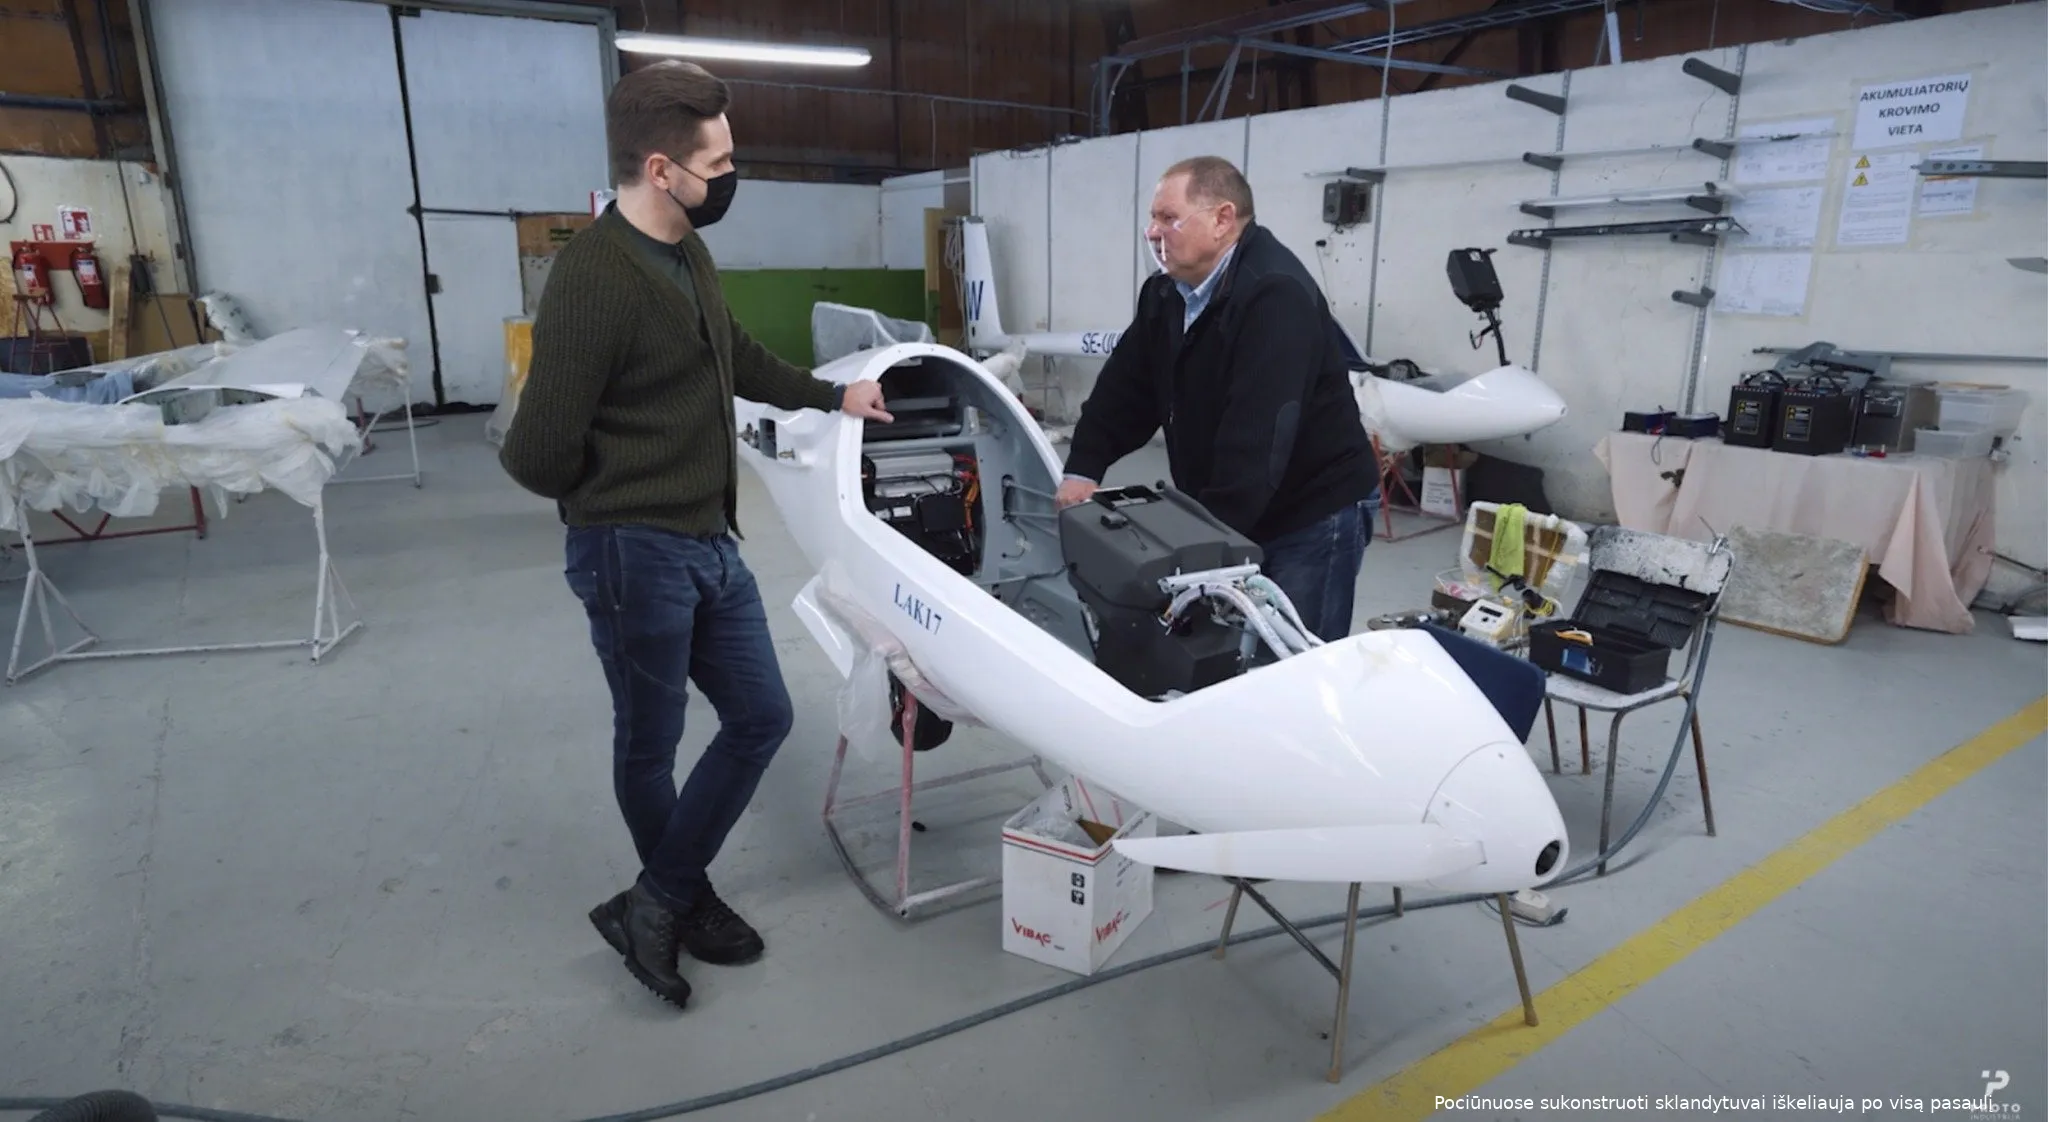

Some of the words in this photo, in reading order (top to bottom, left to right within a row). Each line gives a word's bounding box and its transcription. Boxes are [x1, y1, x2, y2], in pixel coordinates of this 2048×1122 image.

[1860, 80, 1969, 101] AKUMULIATORIŲ
[1879, 103, 1941, 118] KROVIMO
[1888, 124, 1923, 136] VIETA
[894, 583, 942, 635] LAK17
[1012, 917, 1051, 947] VIBAC
